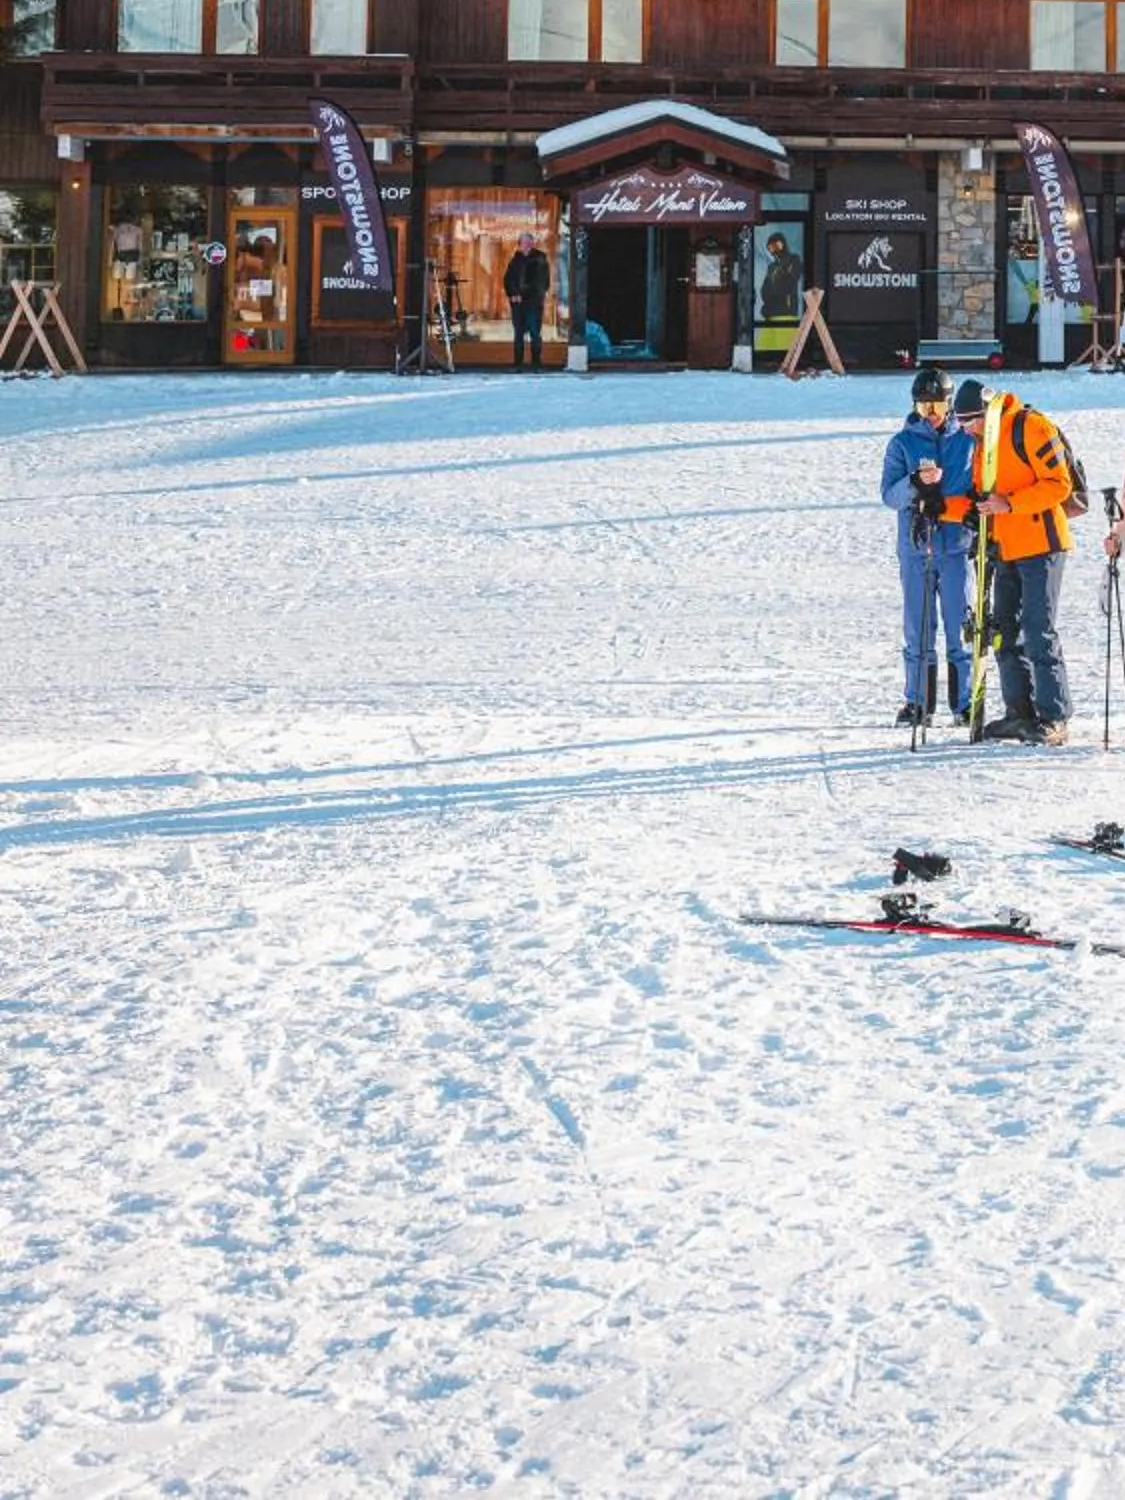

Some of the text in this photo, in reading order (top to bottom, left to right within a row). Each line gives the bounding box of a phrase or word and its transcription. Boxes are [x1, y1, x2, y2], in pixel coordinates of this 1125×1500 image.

[644, 189, 696, 220] Mont
[869, 199, 907, 210] SHOP
[891, 212, 927, 221] RENTAL
[833, 273, 918, 288] SNOWSTONE
